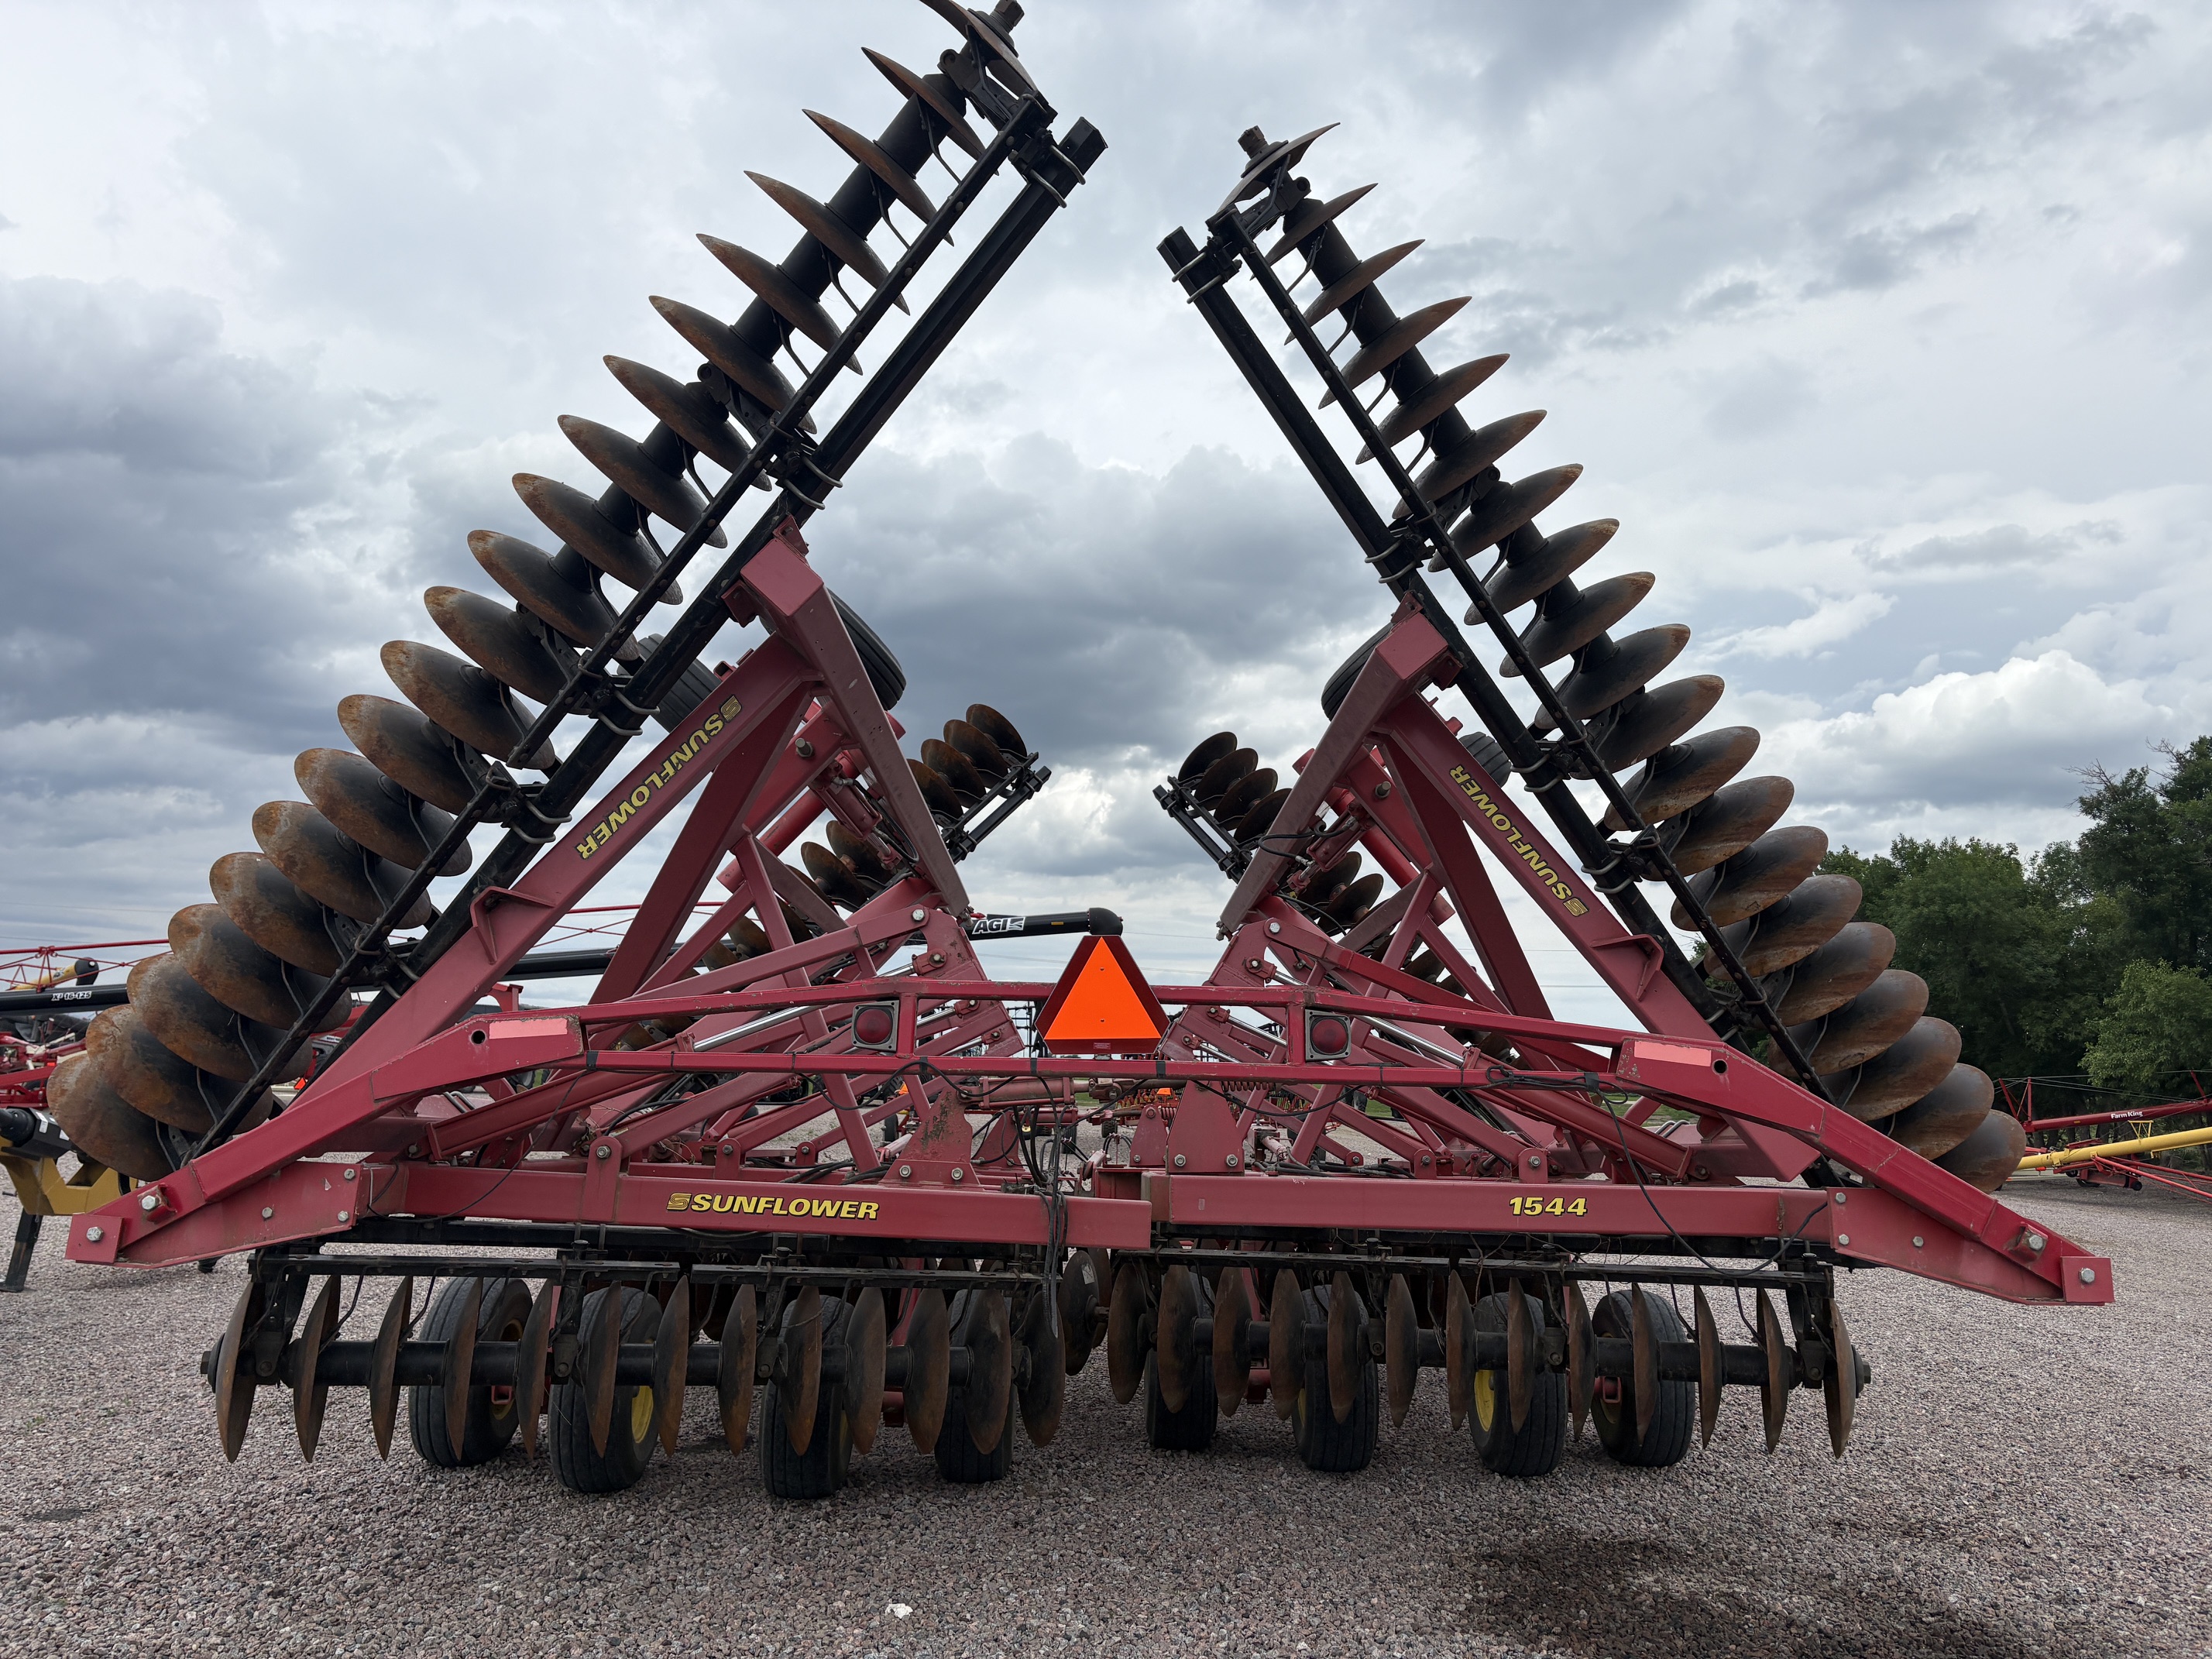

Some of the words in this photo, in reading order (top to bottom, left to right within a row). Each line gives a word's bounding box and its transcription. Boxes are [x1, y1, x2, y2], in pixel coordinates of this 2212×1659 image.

[575, 712, 725, 860] SUNFLOWER
[1448, 764, 1573, 902] SUNFLOWER
[972, 918, 1008, 934] AGI
[64, 991, 92, 1000] 16-125
[691, 1193, 880, 1220] SUNFLOWER
[1509, 1196, 1588, 1217] 1544
